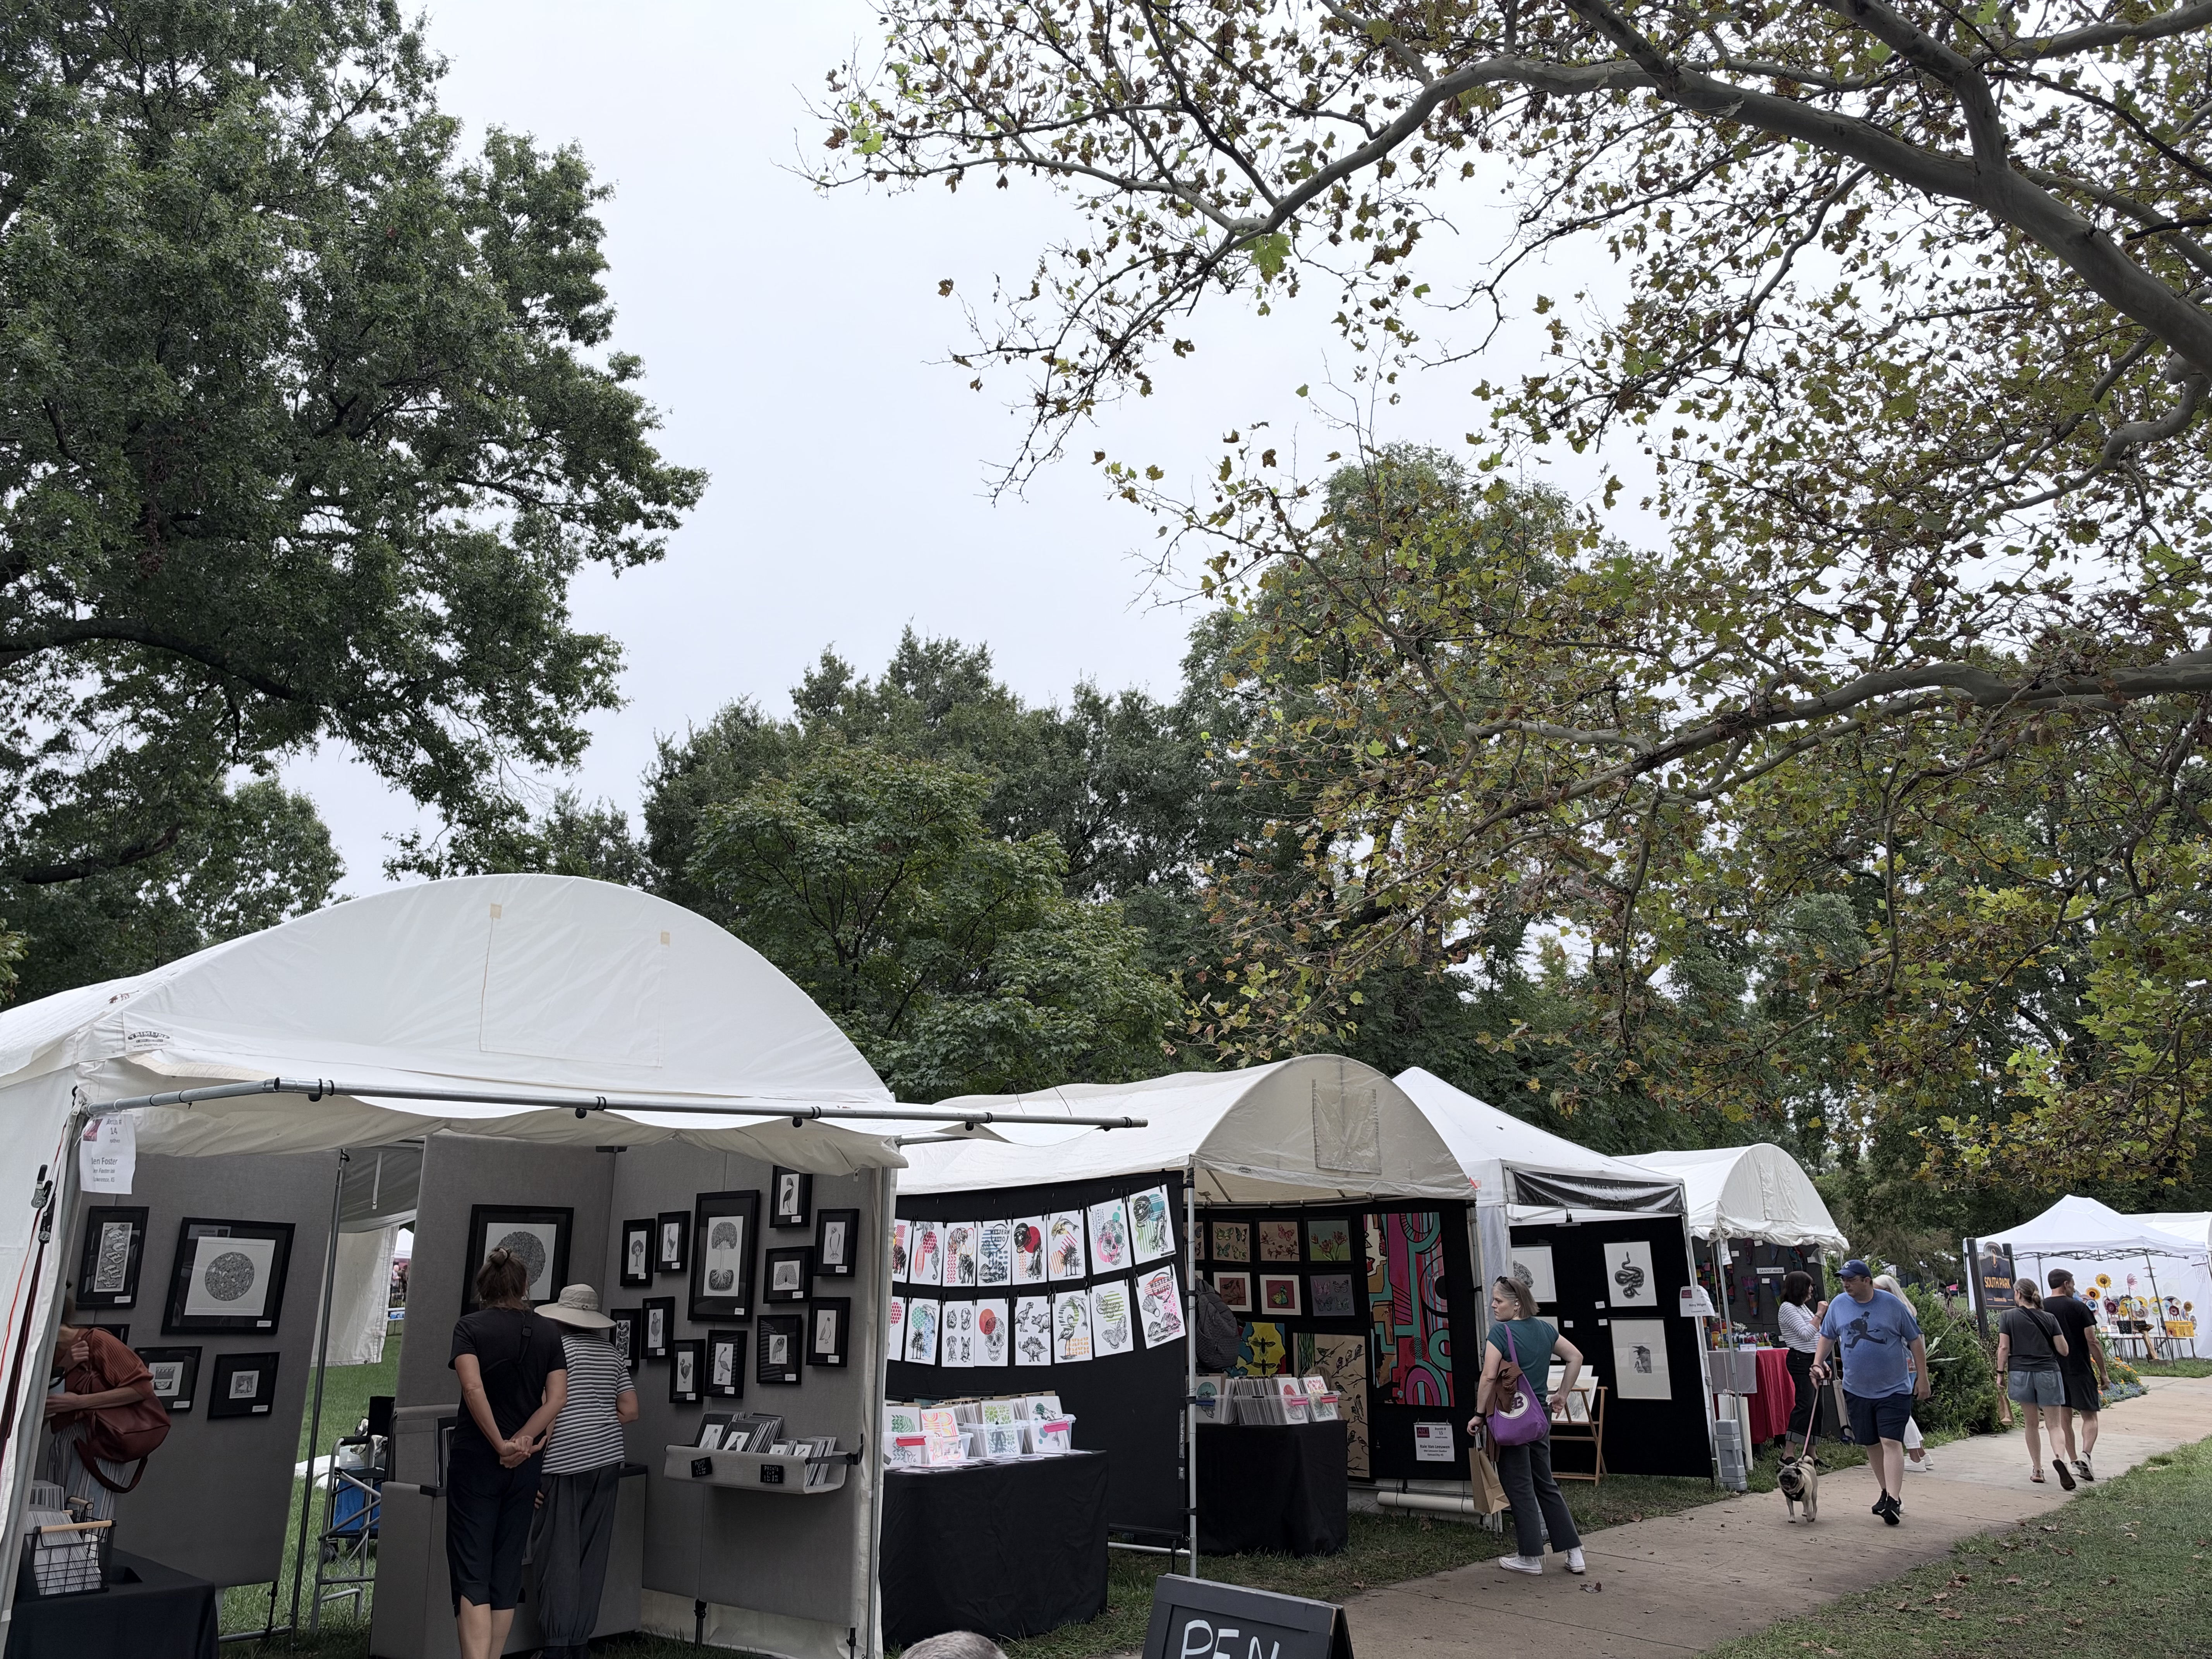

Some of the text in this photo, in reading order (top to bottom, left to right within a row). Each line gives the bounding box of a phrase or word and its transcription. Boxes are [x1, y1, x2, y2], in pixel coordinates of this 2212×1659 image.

[1613, 1186, 1642, 1195] STUDIO
[1150, 1275, 1173, 1288] WESTERN
[1984, 1276, 2011, 1289] SOUTH PARK
[1157, 1284, 1170, 1294] AUTO
